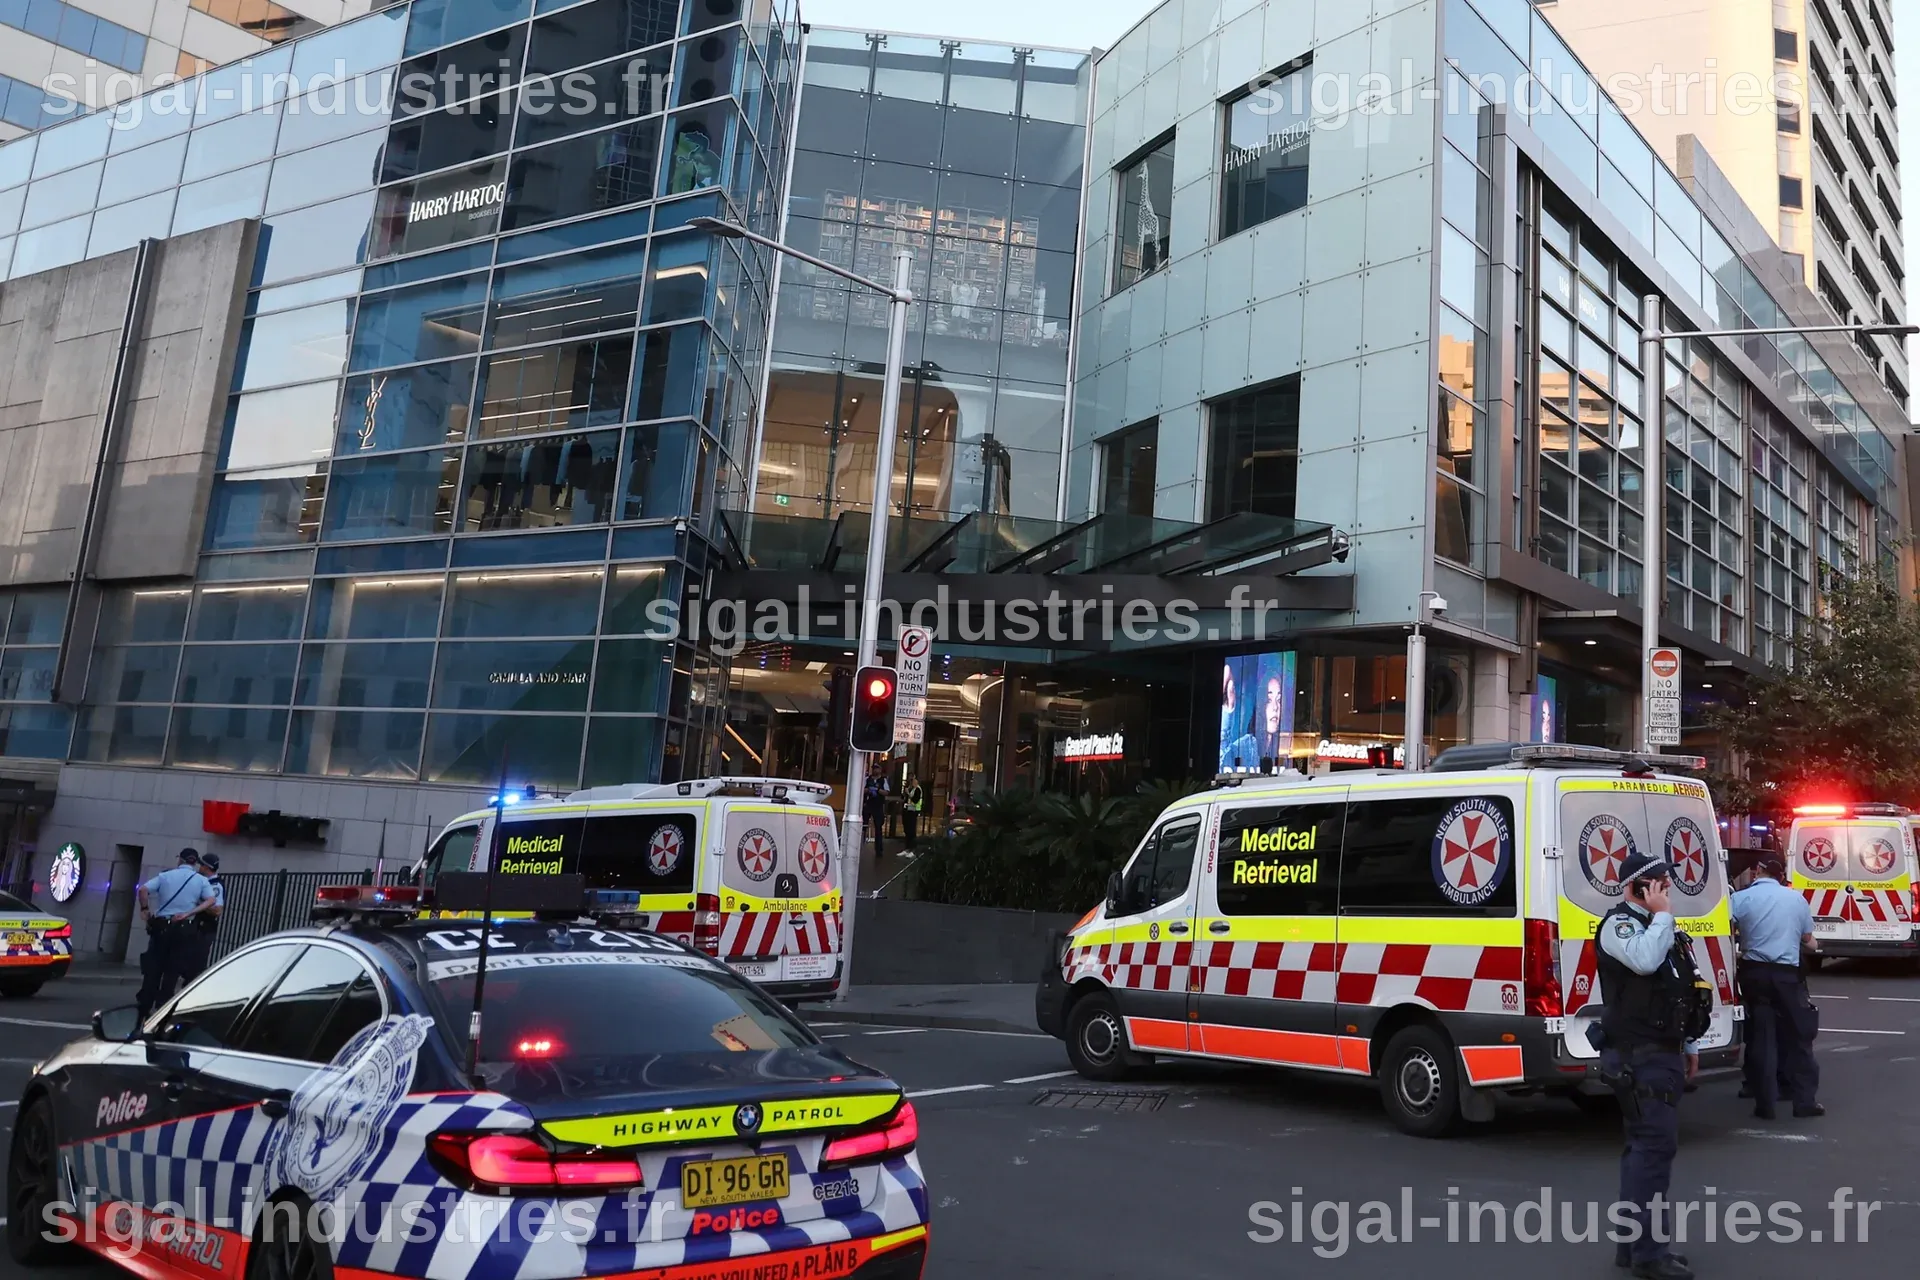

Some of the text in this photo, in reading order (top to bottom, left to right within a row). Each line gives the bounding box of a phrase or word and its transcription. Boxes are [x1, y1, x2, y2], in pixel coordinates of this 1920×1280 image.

[1225, 141, 1264, 173] HARRY
[409, 195, 452, 223] HARRY
[904, 660, 922, 671] NO
[489, 672, 532, 684] CAMILLA
[536, 672, 559, 684] AND
[899, 673, 925, 682] RIGHT
[900, 682, 923, 692] TURN
[1657, 680, 1672, 688] NO
[1612, 781, 1669, 793] PARAMEDIC
[1673, 783, 1705, 798] AER095
[1436, 799, 1509, 842] NEW SOUTH WALES
[1240, 825, 1317, 852] Medical
[1580, 815, 1635, 849] NEW SOUTH WALES
[1665, 825, 1674, 846] NEW
[1673, 817, 1691, 830] SOUTH
[507, 835, 564, 854] Medical
[500, 857, 564, 874] Retrieval
[1233, 858, 1318, 884] Retrieval
[1440, 880, 1497, 904] AMBULANCE
[1673, 877, 1707, 897] AMBULANCE
[1807, 881, 1841, 889] Emergency
[763, 900, 808, 911] Ambulance
[1675, 919, 1714, 932] mbulance
[426, 928, 686, 953] CE 213
[445, 952, 704, 975] Don't Drink & Drive
[1501, 993, 1518, 1004] 000
[96, 1089, 148, 1128] Police
[614, 1116, 722, 1136] HIGHWAY
[773, 1107, 844, 1122] PATROL
[298, 1175, 321, 1189] FORCE
[812, 1179, 860, 1201] CE213
[700, 1189, 774, 1205] NEW SOUTH WALES
[693, 1207, 779, 1234] Police
[753, 1263, 788, 1280] NEED
[791, 1262, 800, 1279] A
[804, 1248, 845, 1276] PLAN
[847, 1248, 858, 1269] B
